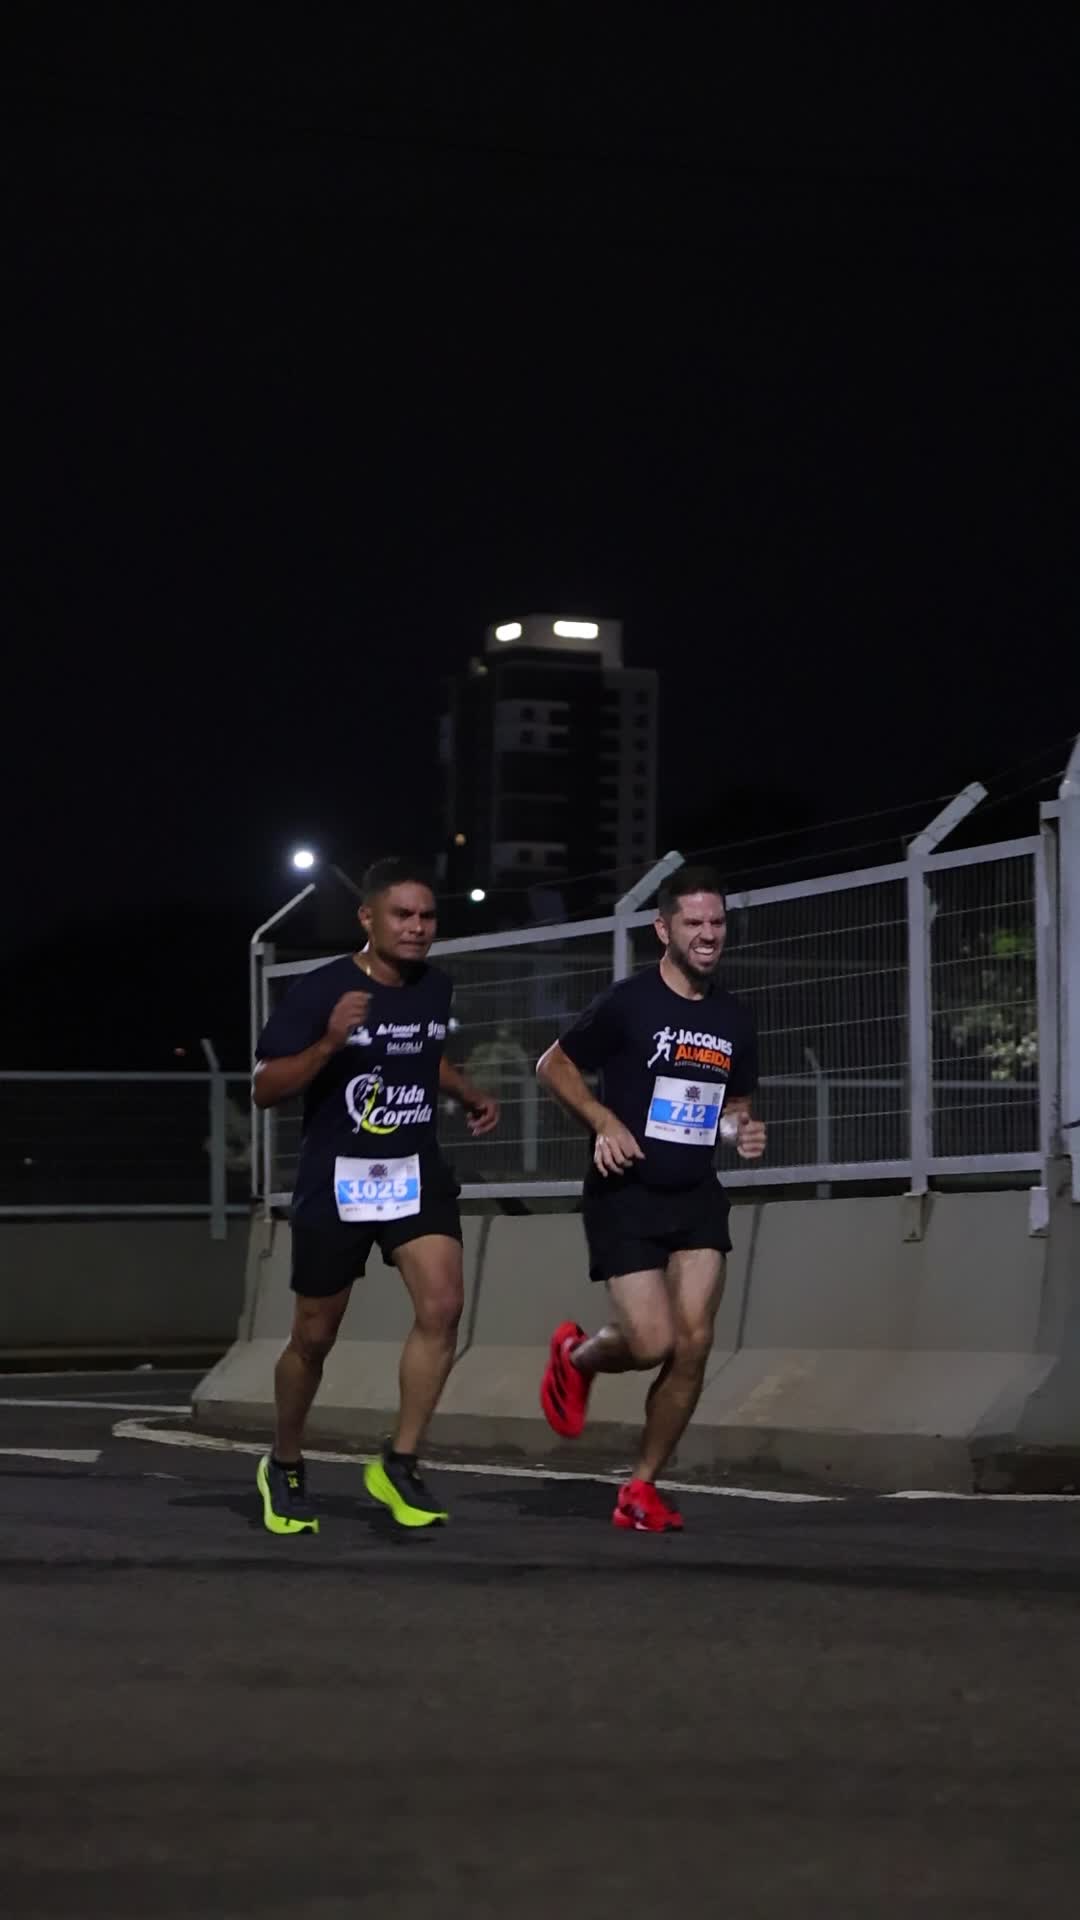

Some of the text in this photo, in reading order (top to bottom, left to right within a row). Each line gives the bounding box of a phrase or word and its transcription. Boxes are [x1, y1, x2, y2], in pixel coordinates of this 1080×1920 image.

[676, 1029, 733, 1056] JACQUES
[675, 1045, 731, 1072] ALMEIDA
[386, 1085, 425, 1105] Vida
[368, 1104, 432, 1126] Corrida
[670, 1101, 706, 1123] 712
[349, 1179, 408, 1200] 1025
